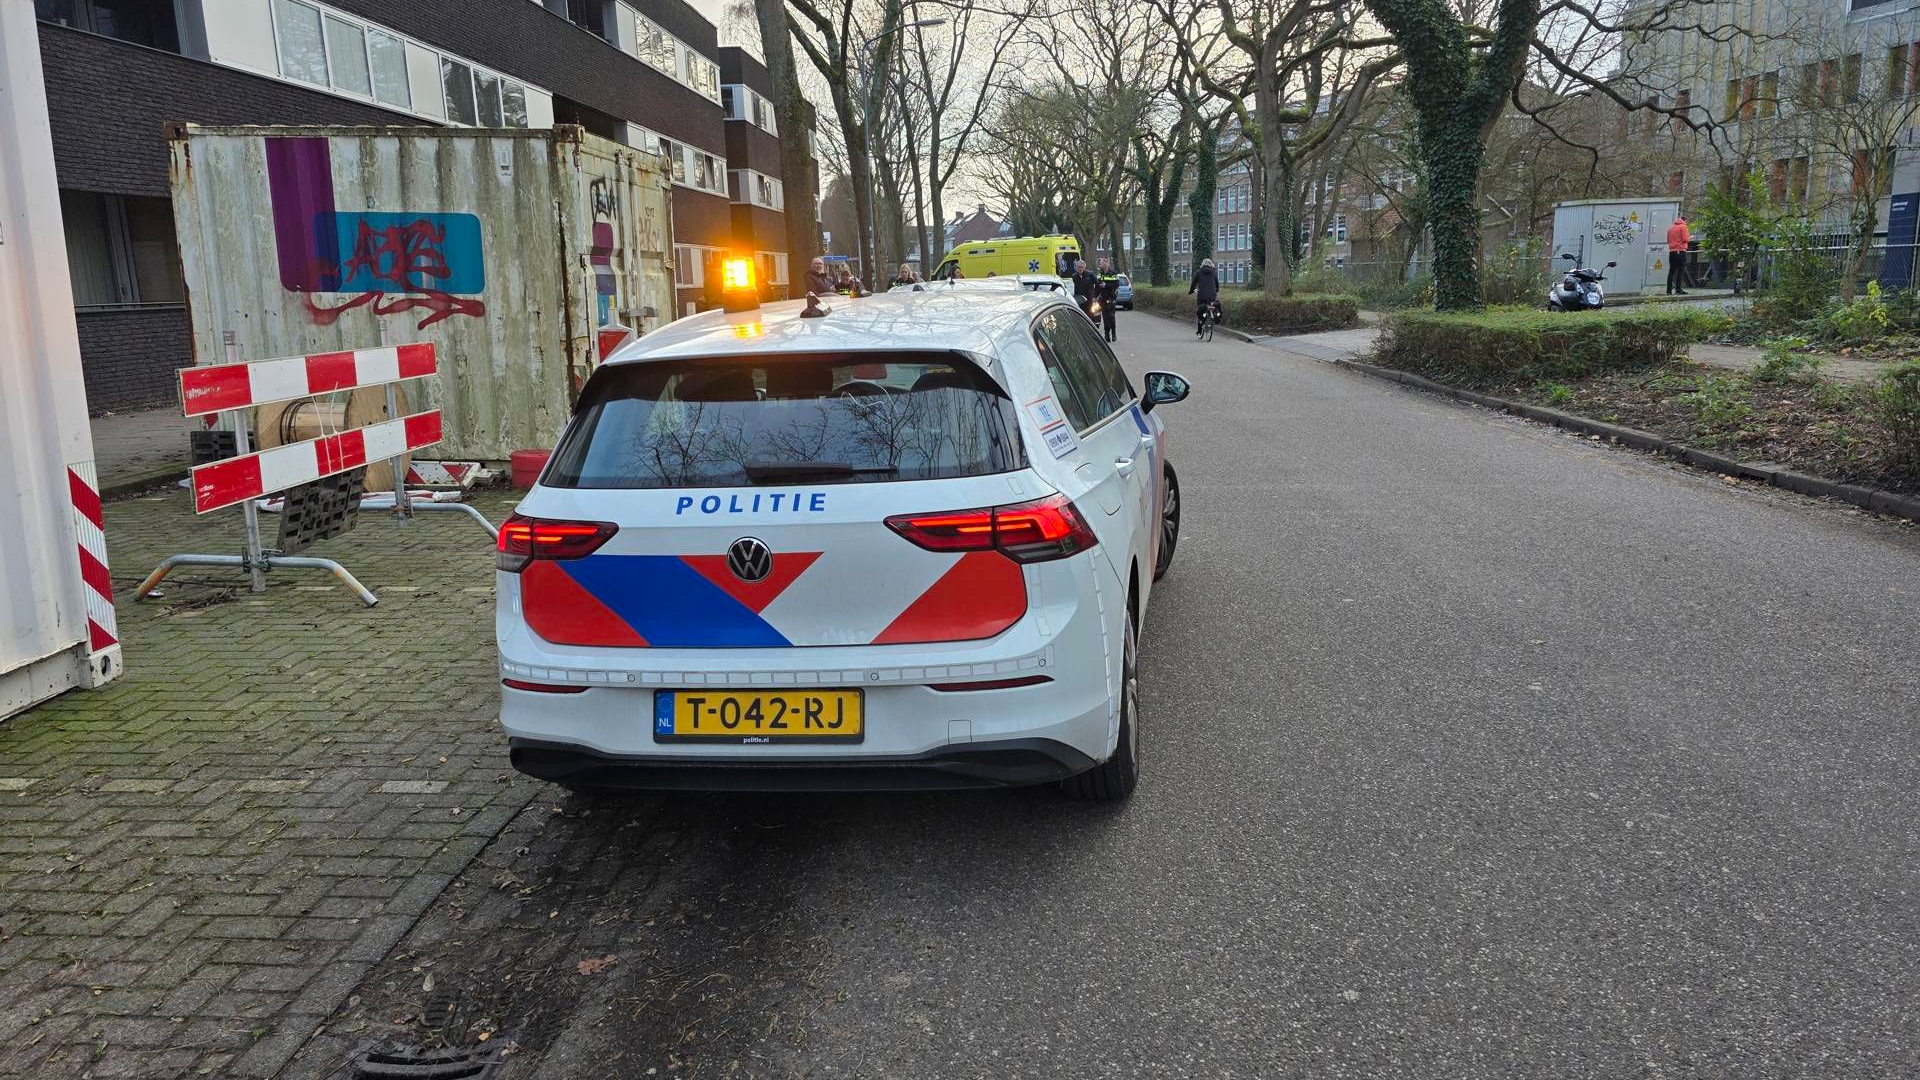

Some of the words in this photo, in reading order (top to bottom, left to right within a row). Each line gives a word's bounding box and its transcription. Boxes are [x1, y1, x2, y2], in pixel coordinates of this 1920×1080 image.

[676, 493, 826, 515] POLITIE
[729, 539, 770, 580] VW
[659, 718, 673, 727] NL
[687, 697, 843, 729] T-042-RJ
[743, 736, 770, 744] politie.nl
